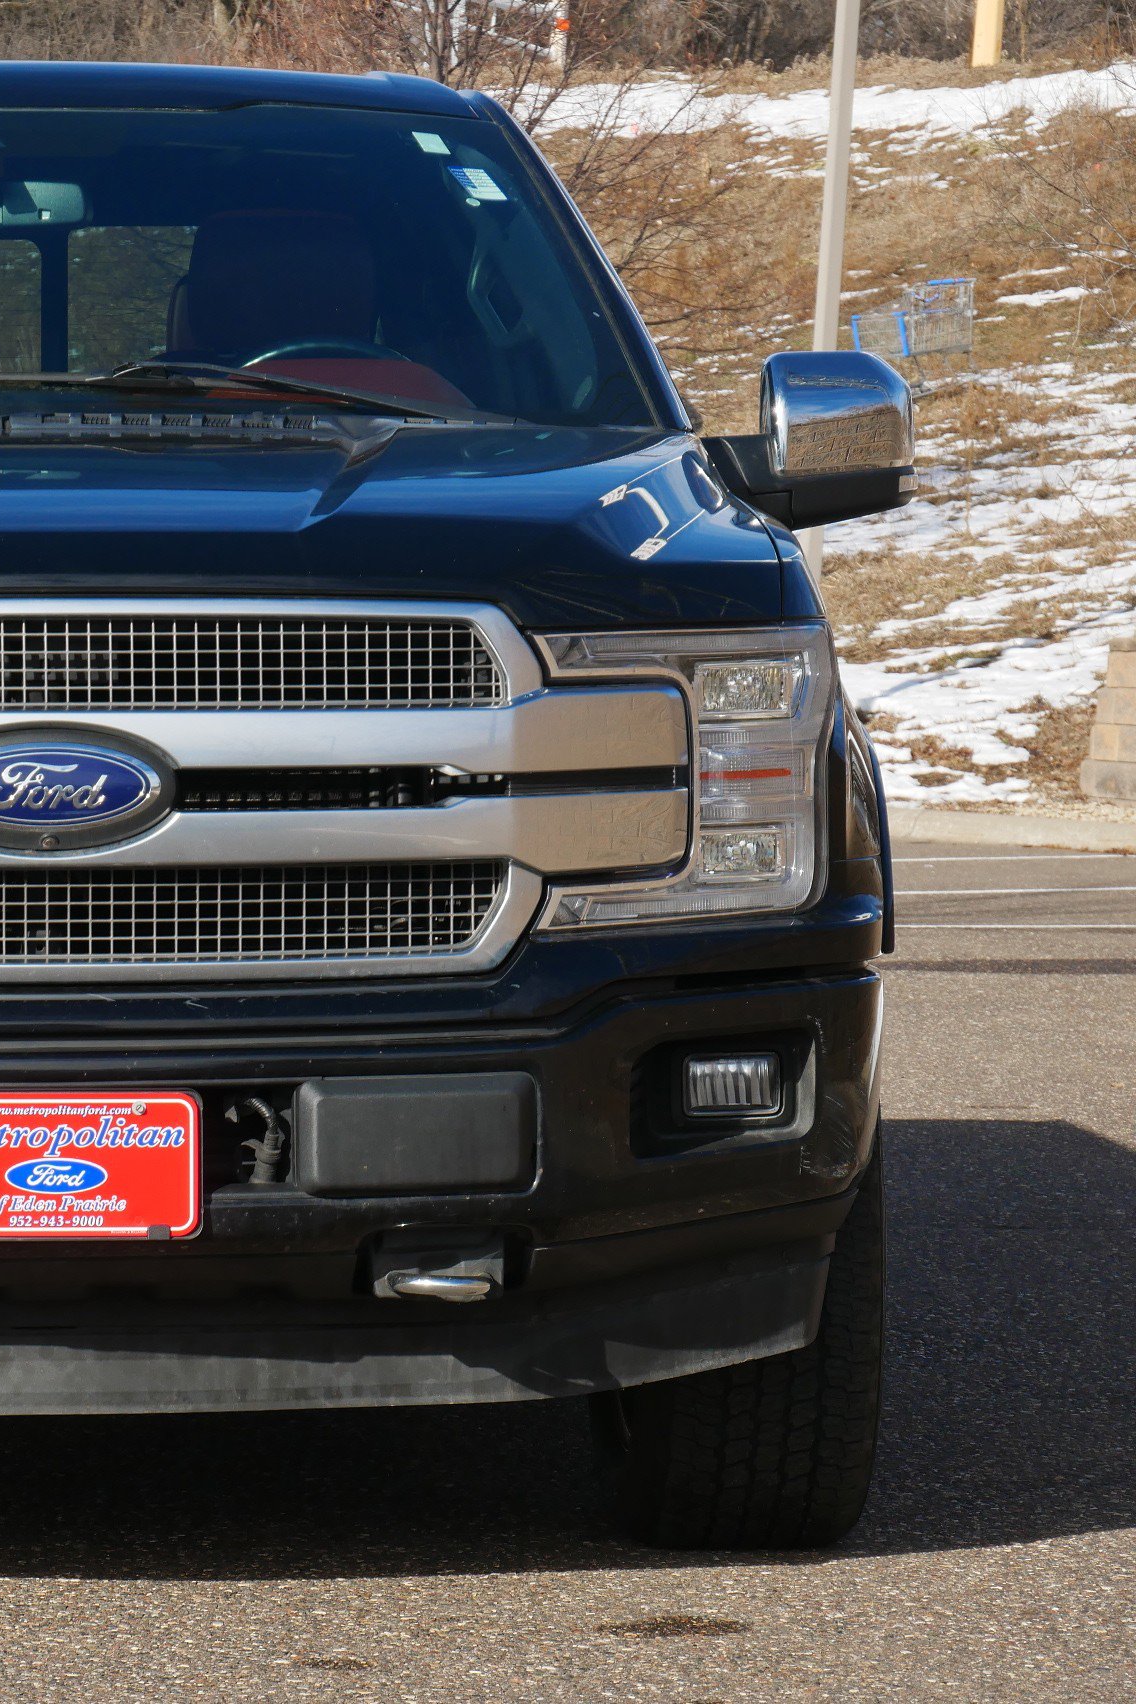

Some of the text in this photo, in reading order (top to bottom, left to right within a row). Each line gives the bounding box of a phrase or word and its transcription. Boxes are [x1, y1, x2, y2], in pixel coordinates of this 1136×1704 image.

[26, 1164, 86, 1187] Ford
[8, 1195, 57, 1212] Eden
[60, 1195, 127, 1212] Prairie
[9, 1215, 104, 1227] 952-943-9000
